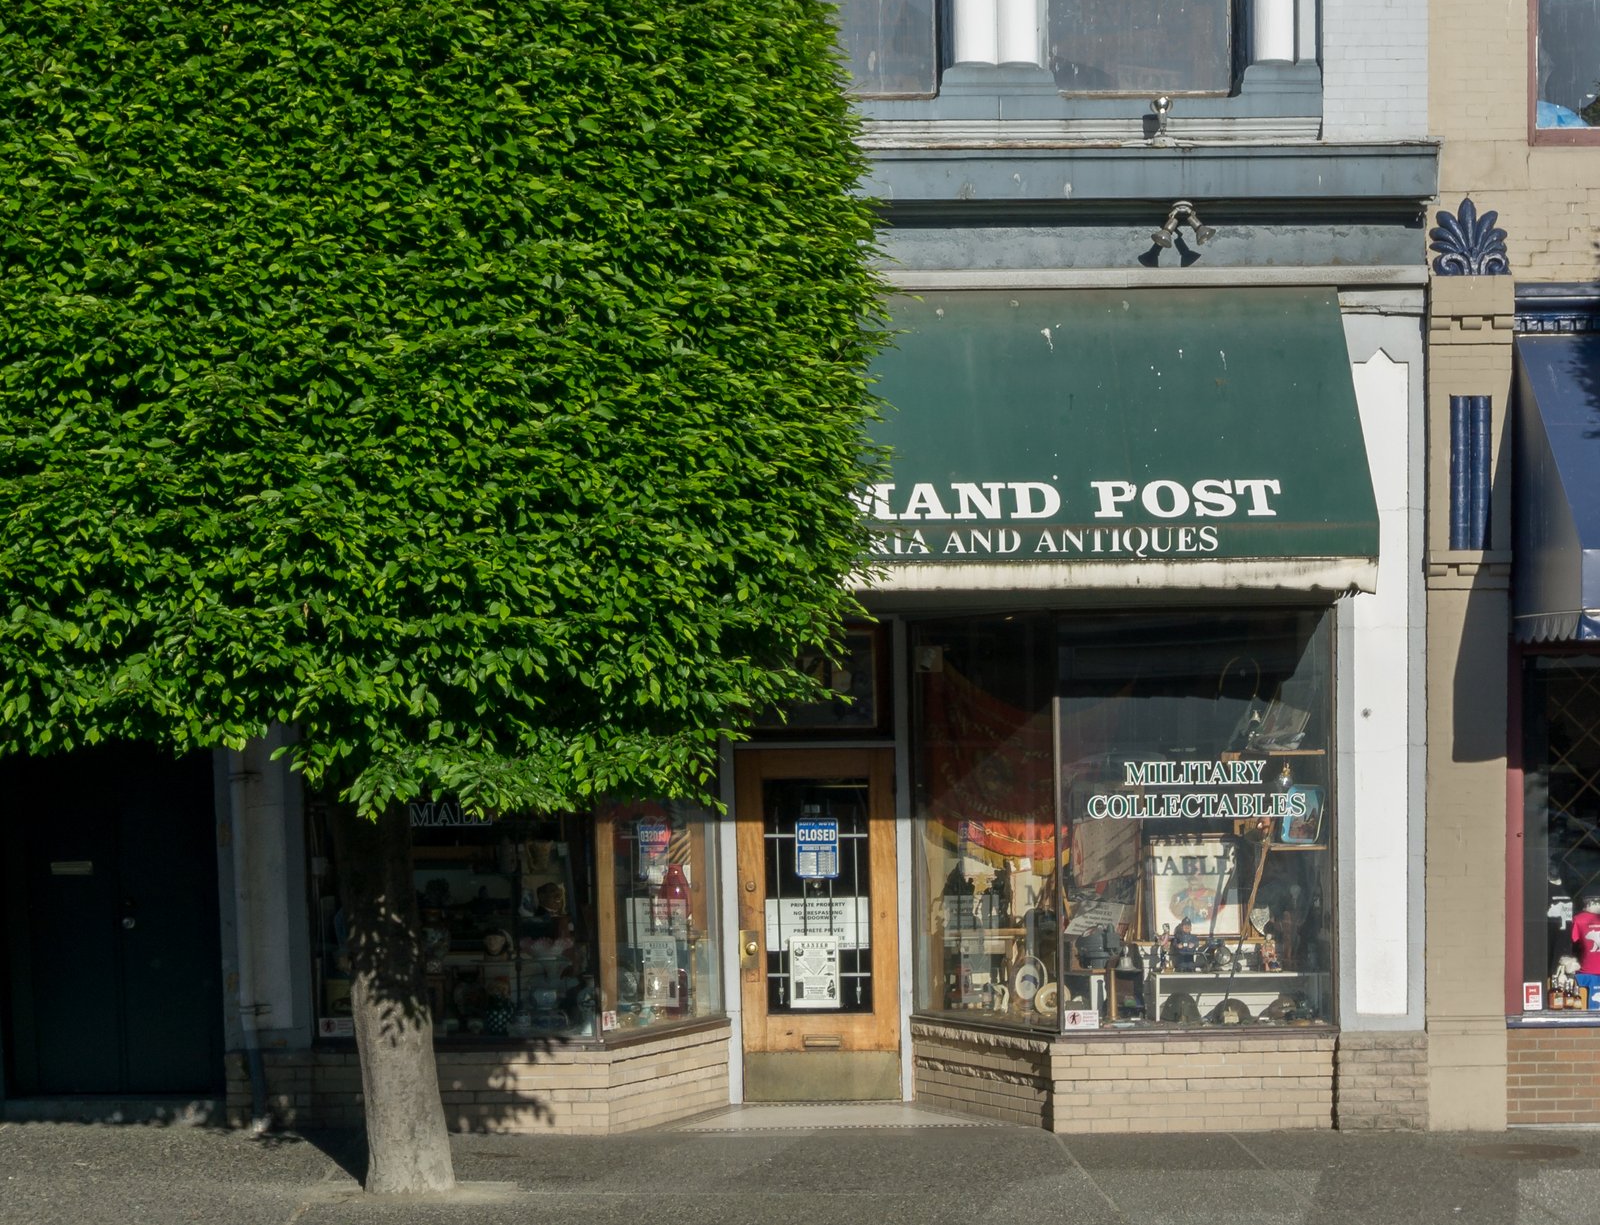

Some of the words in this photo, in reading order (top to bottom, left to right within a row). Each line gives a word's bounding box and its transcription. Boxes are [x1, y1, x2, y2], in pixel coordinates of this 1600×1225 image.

[1091, 479, 1281, 518] POST
[942, 527, 1022, 554] AND
[1034, 525, 1220, 558] ANTIQUES
[1124, 760, 1267, 786] MILITARY
[1087, 793, 1307, 819] COLLECTABLES
[799, 829, 836, 842] CLOSED
